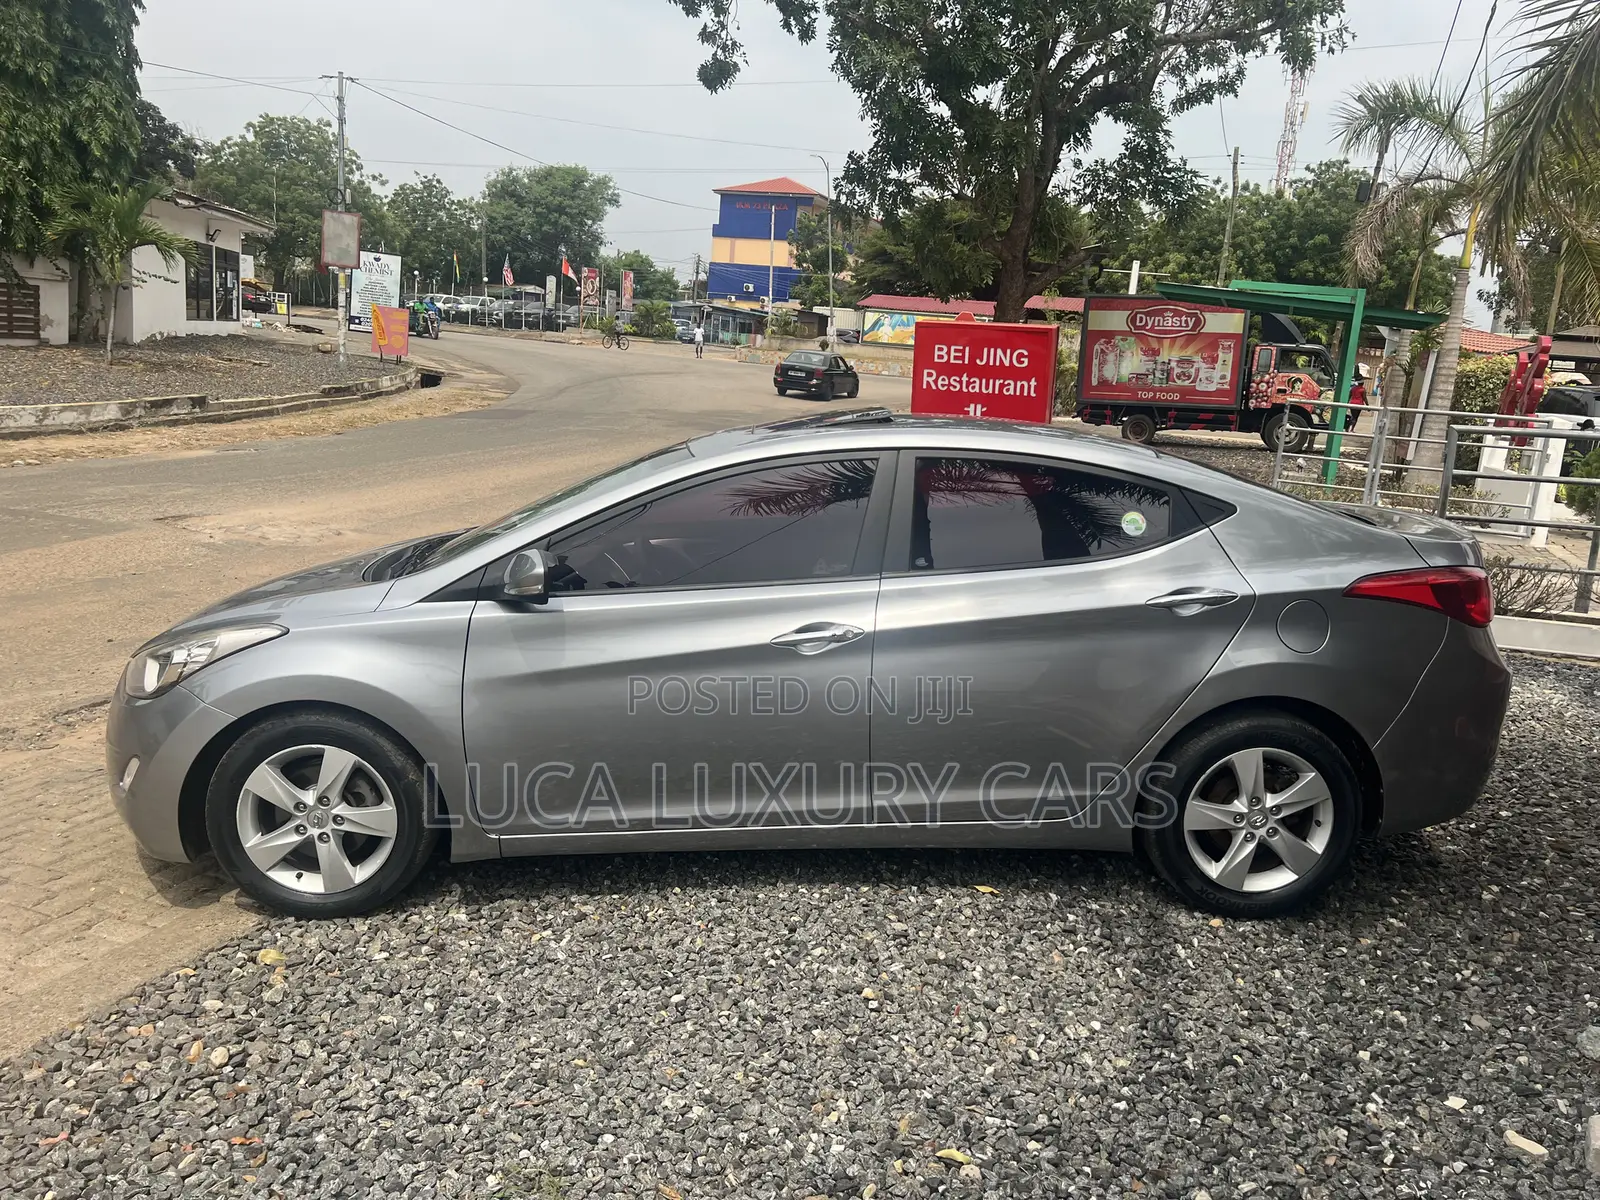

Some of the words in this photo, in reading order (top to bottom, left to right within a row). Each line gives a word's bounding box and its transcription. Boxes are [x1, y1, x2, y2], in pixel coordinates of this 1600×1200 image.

[359, 267, 394, 276] CHEMIST
[1136, 312, 1196, 331] Dynasty
[934, 344, 970, 365] BEI
[975, 347, 1029, 368] JING
[922, 369, 1038, 397] Restaurant
[1137, 390, 1154, 399] TOP
[1156, 392, 1180, 400] FOOD
